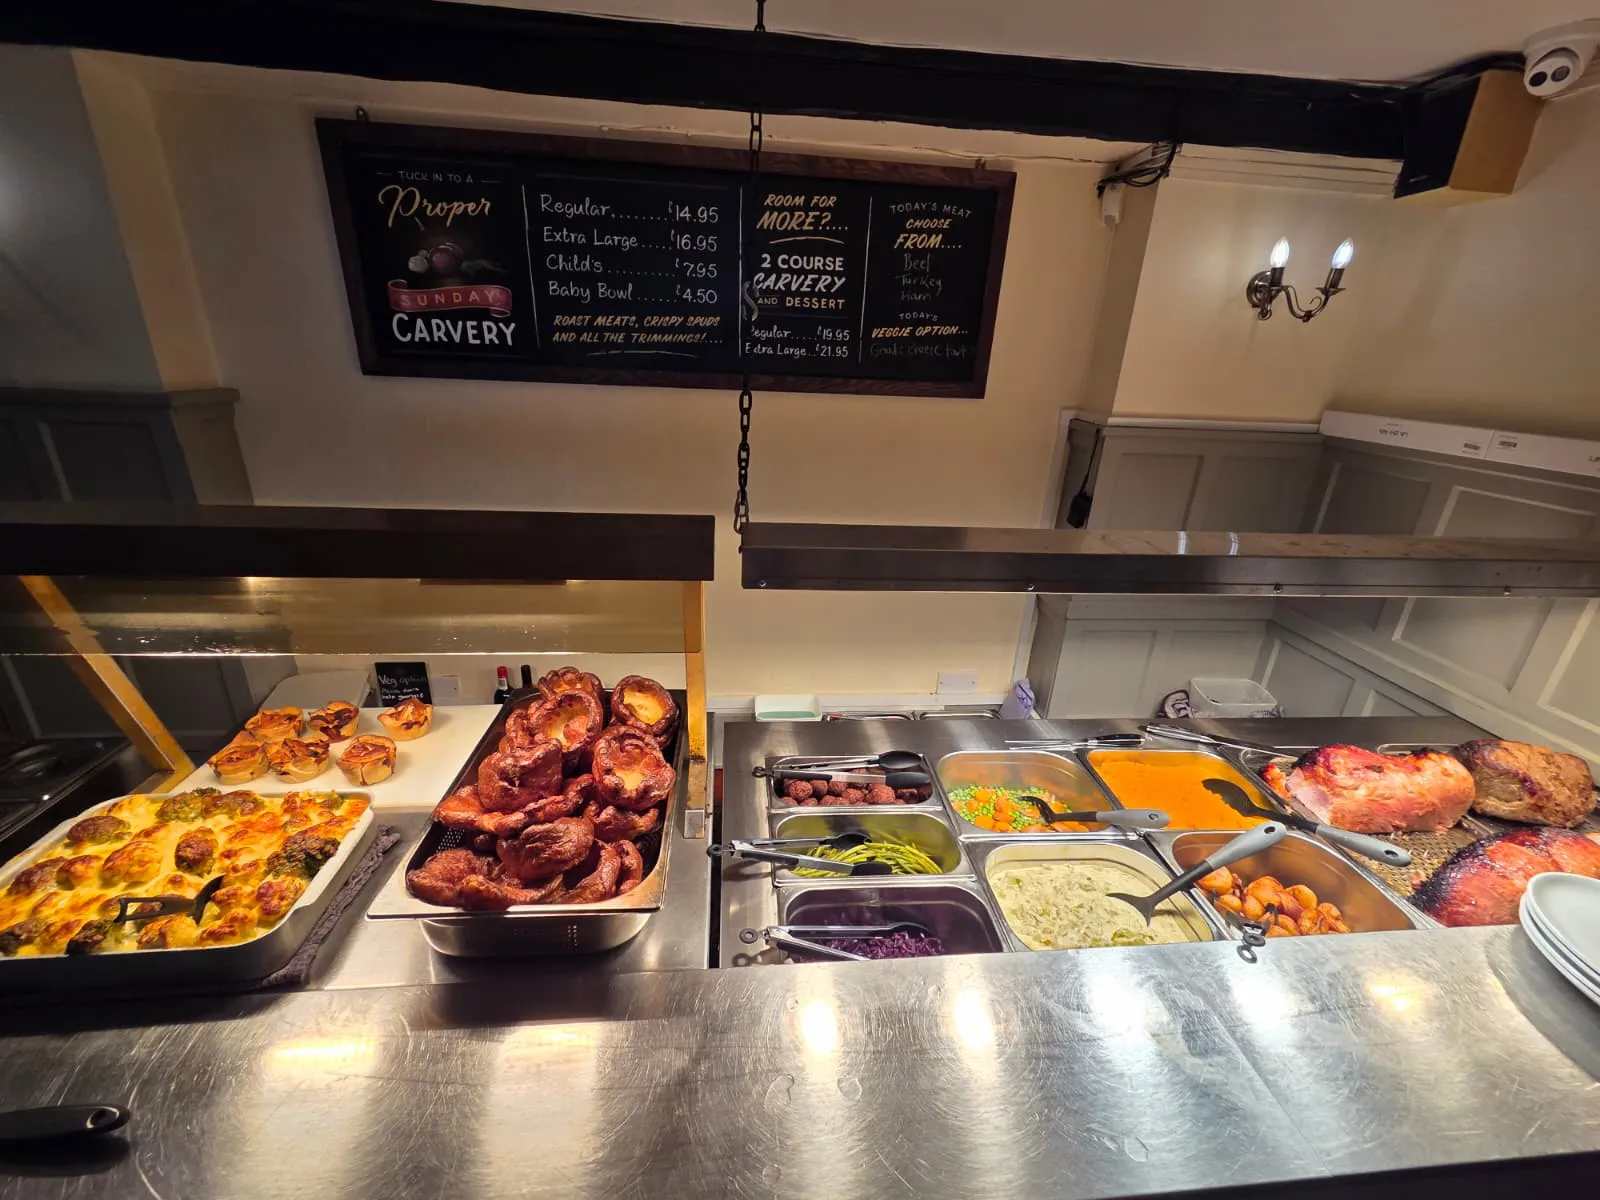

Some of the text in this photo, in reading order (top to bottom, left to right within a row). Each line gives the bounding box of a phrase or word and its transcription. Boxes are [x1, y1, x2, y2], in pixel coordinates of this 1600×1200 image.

[398, 171, 474, 184] TUCK IN TO A
[378, 184, 491, 228] Proper
[764, 194, 838, 208] ROOM FOR
[668, 200, 719, 223] £14.95
[889, 201, 973, 219] TODAY'S MEAT
[905, 218, 953, 230] CHOOSE
[543, 226, 587, 244] Extra
[670, 229, 718, 252] £16.95
[675, 258, 718, 278] £7.95
[760, 253, 844, 271] 2 COURSE
[753, 272, 847, 293] CARVERY
[894, 272, 943, 297] Turkey
[400, 290, 495, 306] SUNDAY
[548, 280, 591, 304] Baby
[676, 284, 718, 304] £4.50
[757, 297, 846, 310] AND DESSERT
[553, 315, 721, 328] ROAST MEATS, CRISPY SPUDS
[898, 312, 940, 322] TODAY'S
[392, 313, 516, 346] CARVERY
[552, 332, 577, 344] AND
[579, 332, 600, 343] ALL
[603, 332, 626, 343] THE
[871, 326, 913, 339] VEGGIE
[378, 673, 398, 688] Veg
